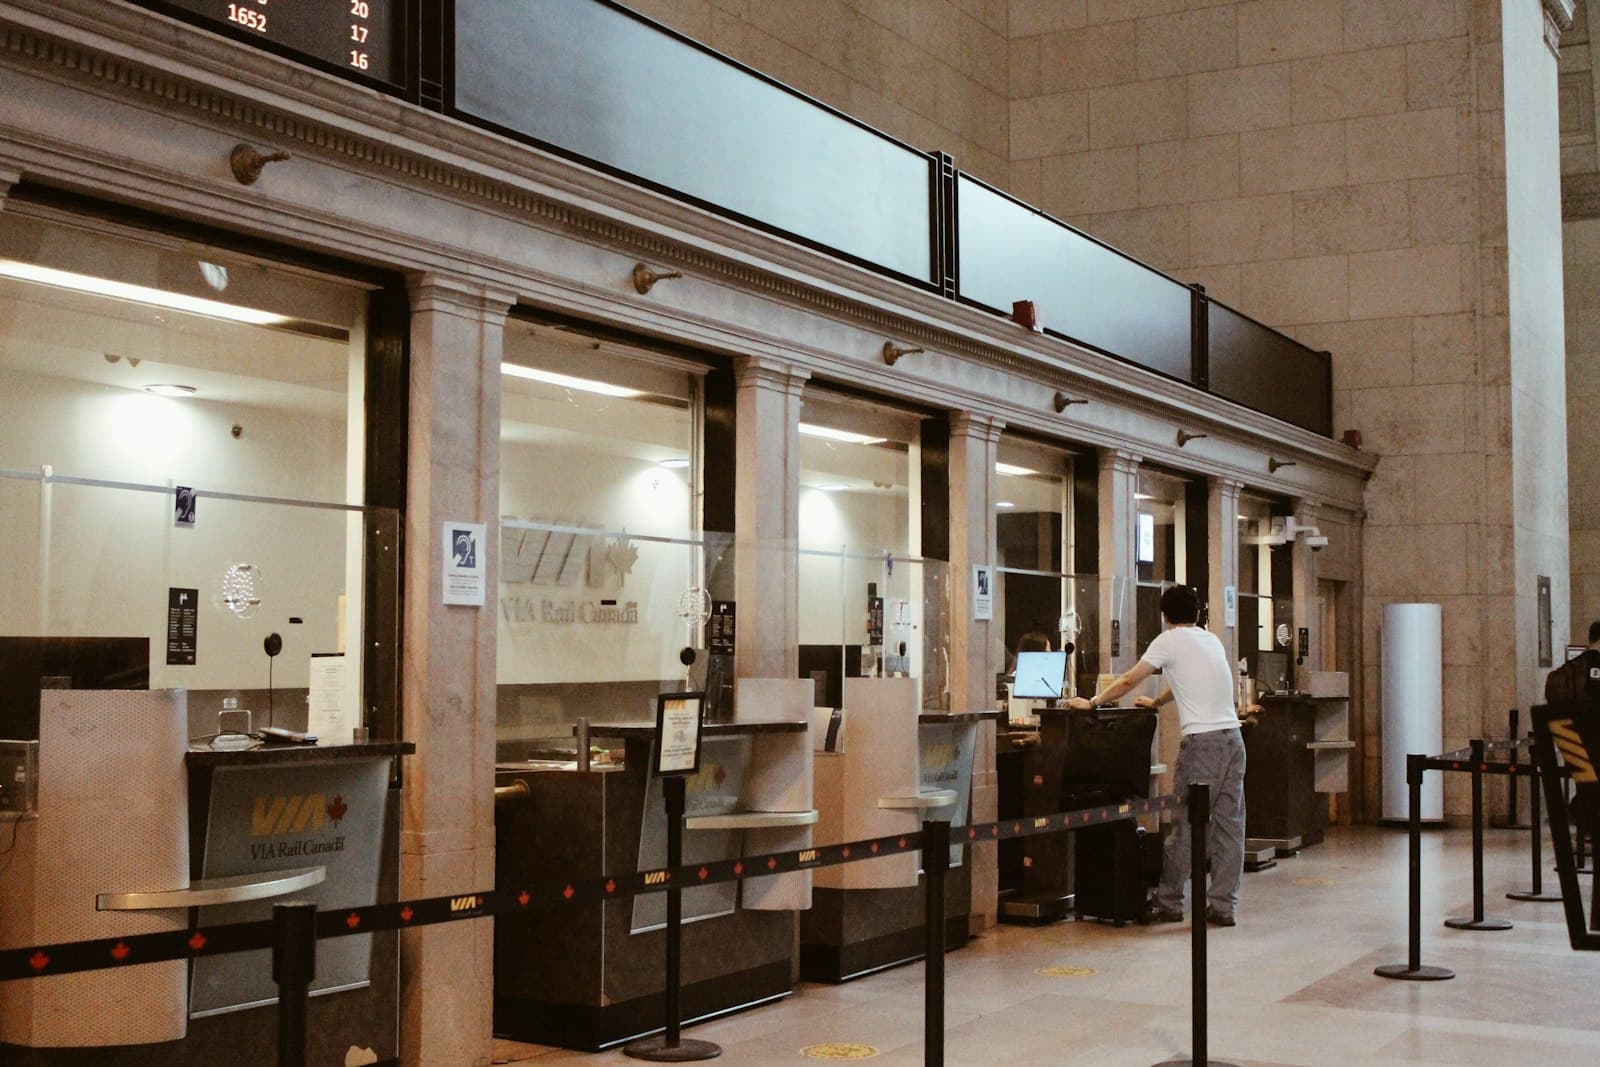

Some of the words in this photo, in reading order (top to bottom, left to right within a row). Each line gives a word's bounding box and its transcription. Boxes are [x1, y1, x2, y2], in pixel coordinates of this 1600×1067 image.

[228, 3, 267, 33] 1652
[350, 0, 369, 19] 20
[350, 24, 369, 43] 17
[350, 50, 369, 70] 16
[541, 599, 575, 624] Rail
[577, 601, 639, 625] Canada
[251, 792, 326, 836] VIA
[251, 843, 276, 860] VIA
[278, 840, 303, 858] Rail
[303, 836, 345, 856] Canada
[644, 871, 665, 885] VIA
[451, 896, 476, 911] VIA
